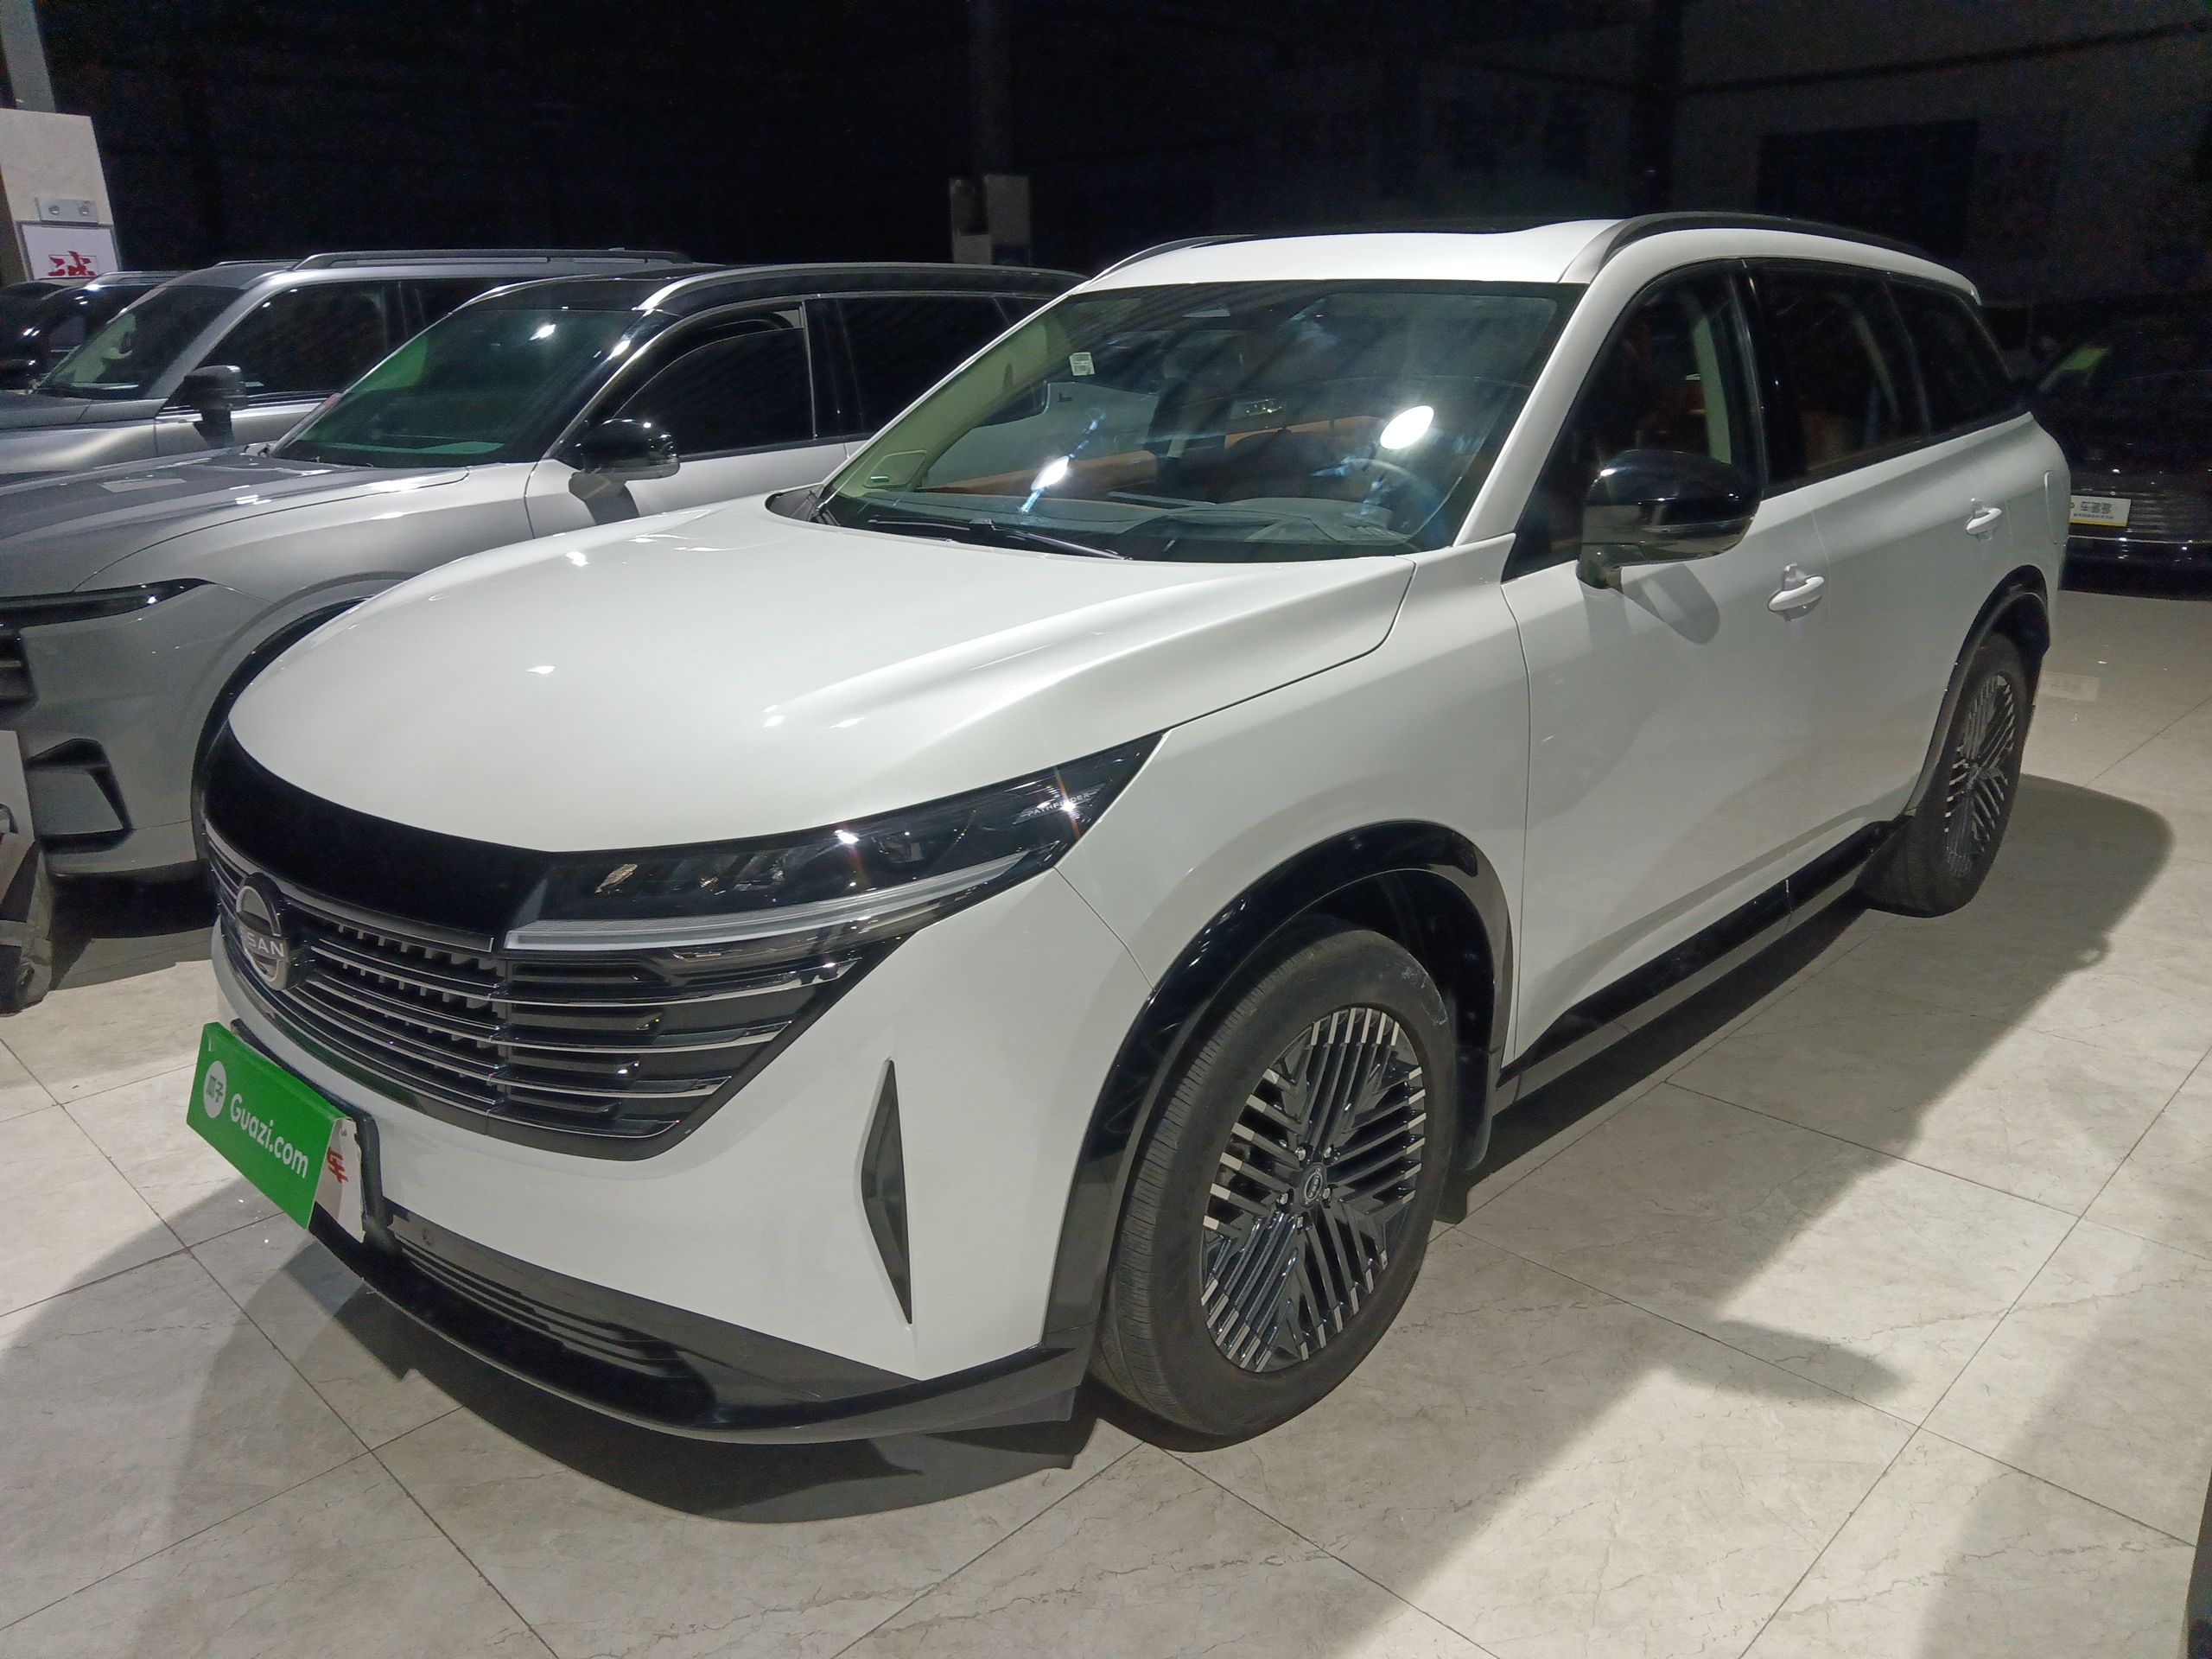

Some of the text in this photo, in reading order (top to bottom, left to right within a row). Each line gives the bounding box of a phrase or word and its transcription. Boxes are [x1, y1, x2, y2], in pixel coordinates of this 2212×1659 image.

[1027, 792, 1090, 817] PATHFIDER
[245, 931, 285, 957] SAN
[230, 1093, 308, 1179] Guazi.com
